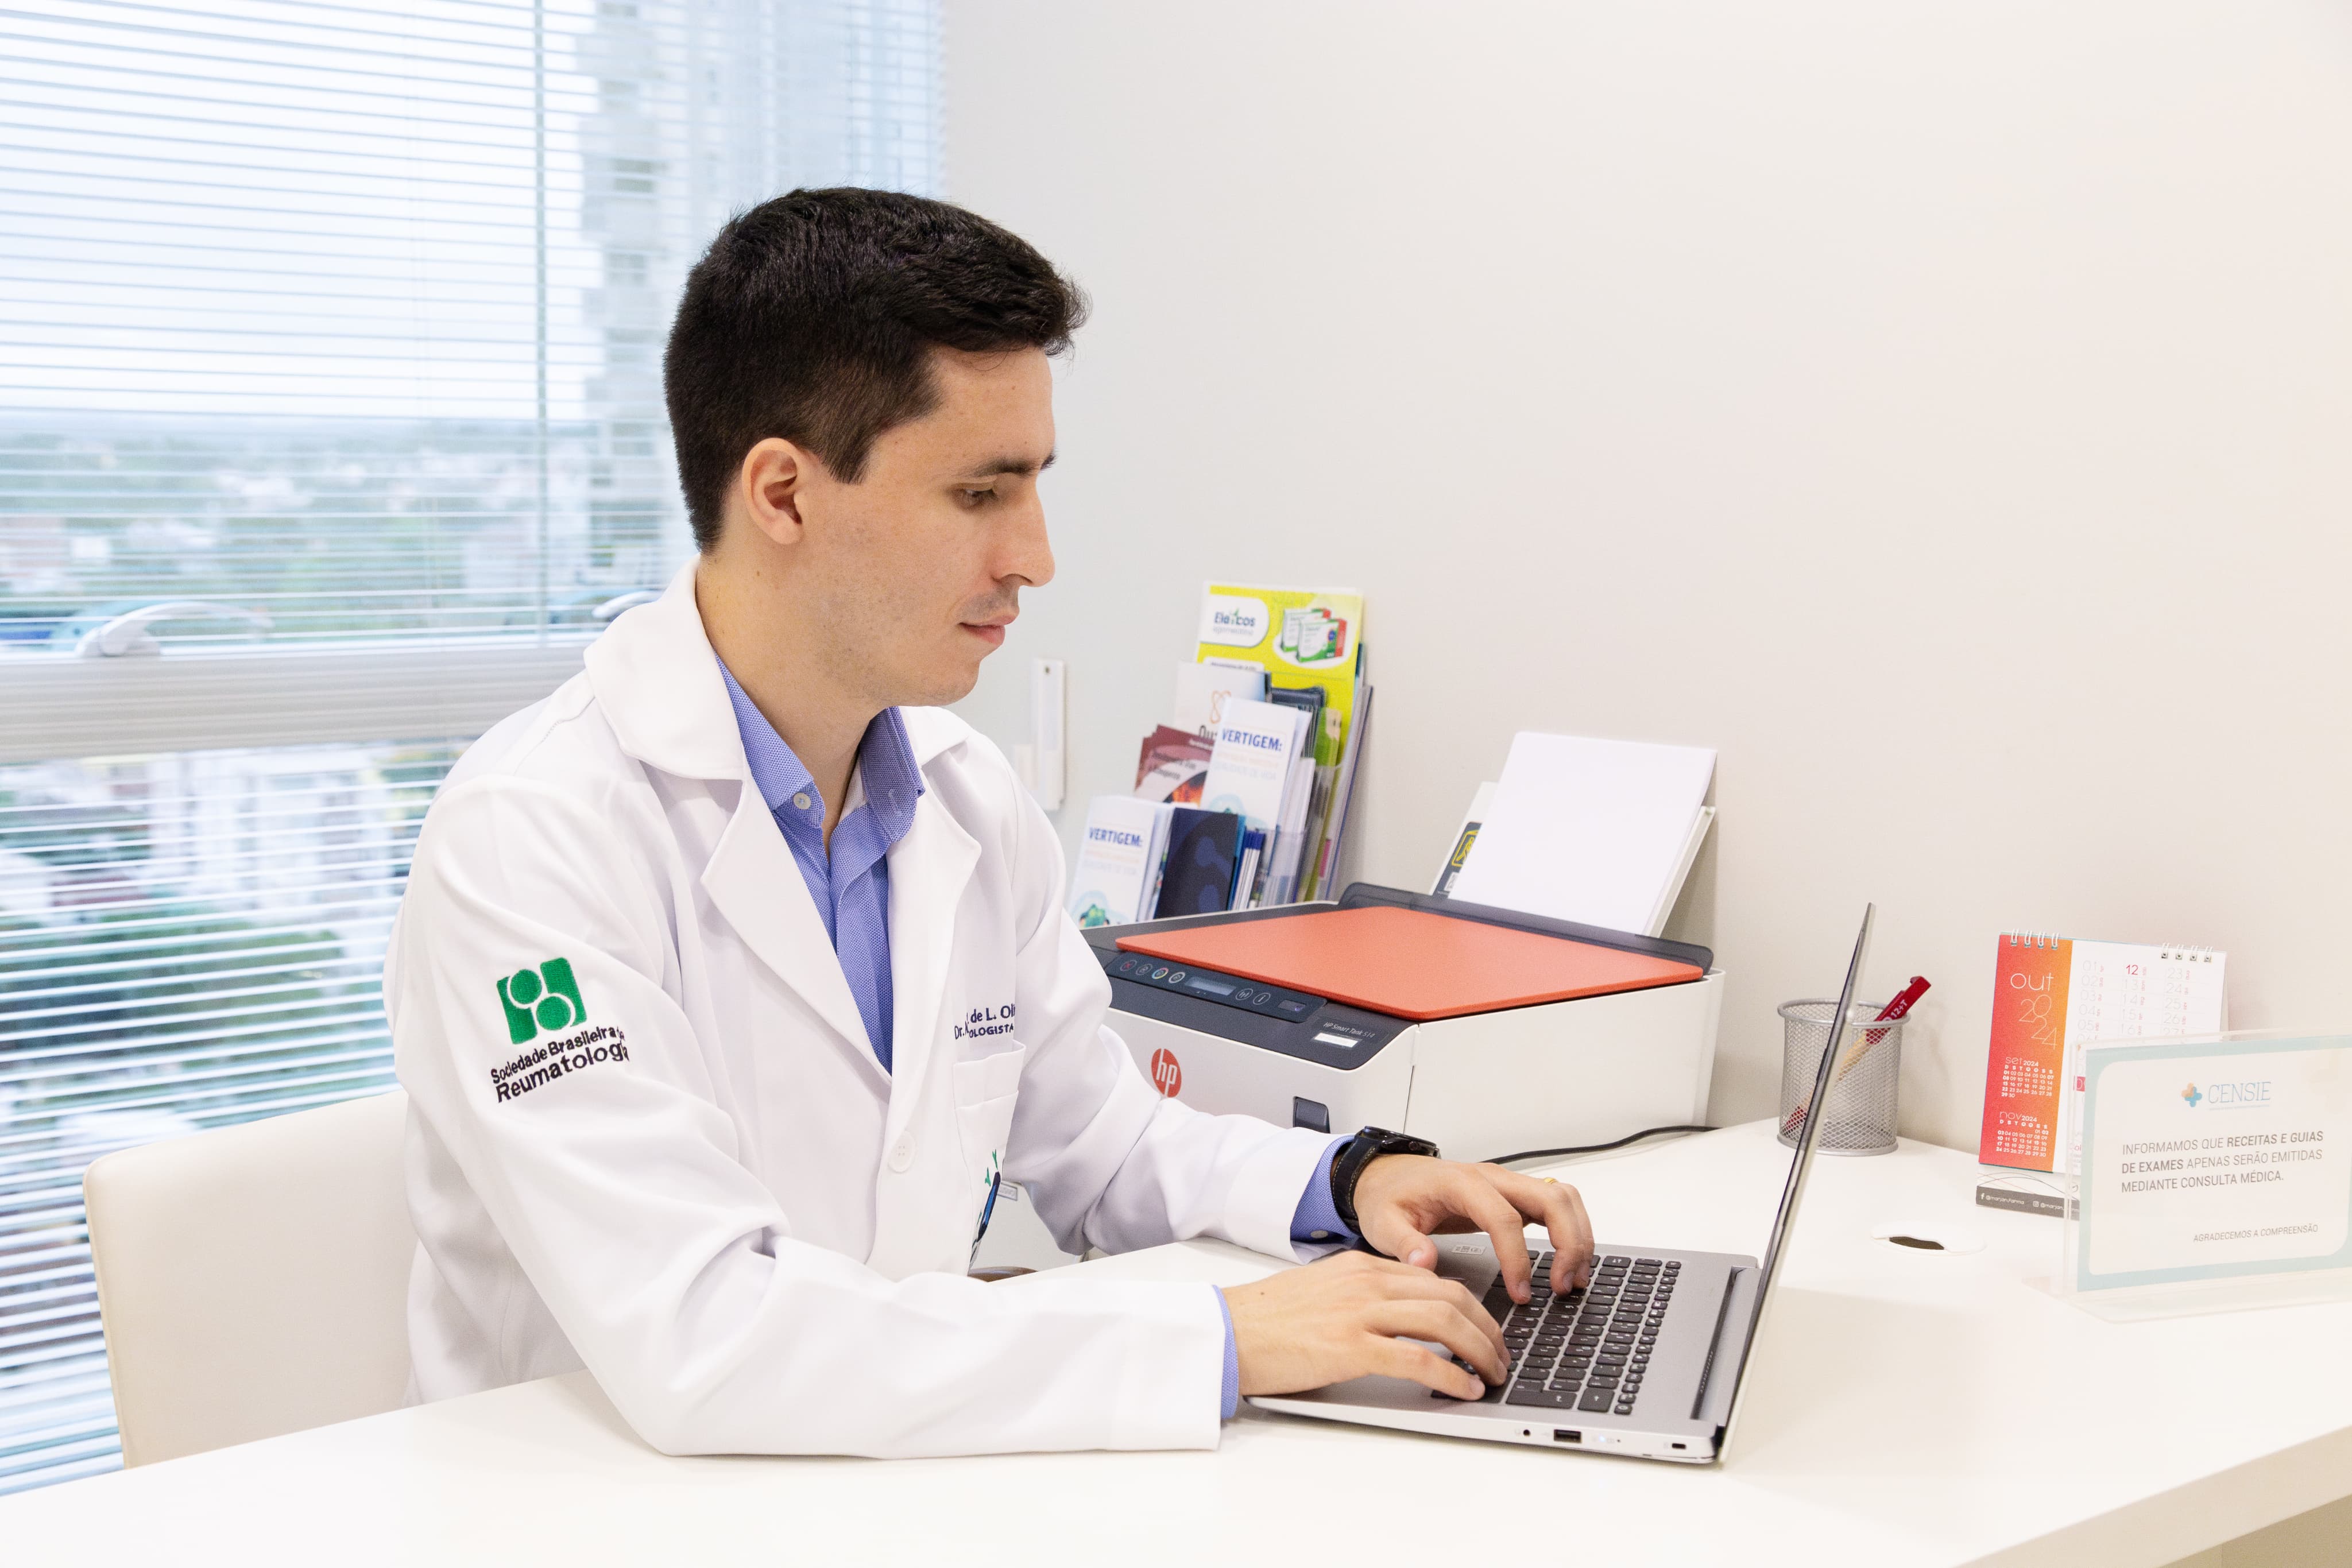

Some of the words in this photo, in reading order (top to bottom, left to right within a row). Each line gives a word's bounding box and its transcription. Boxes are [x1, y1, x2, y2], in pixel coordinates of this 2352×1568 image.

[1223, 728, 1282, 751] VERTIGEM:
[2126, 965, 2138, 975] 12
[2168, 968, 2183, 979] 23
[2010, 973, 2054, 992] out
[2167, 983, 2183, 993] 24
[2080, 990, 2096, 1001] 03
[2123, 994, 2138, 1005] 14
[2165, 997, 2182, 1010] 25
[970, 1009, 982, 1023] de
[2079, 1005, 2096, 1016] 04
[2122, 1009, 2136, 1020] 15
[2164, 1012, 2181, 1024] 26
[2077, 1020, 2095, 1031] 05
[2121, 1024, 2136, 1035] 16
[2006, 1056, 2022, 1064] set
[1154, 1048, 1178, 1096] hp
[2208, 1082, 2271, 1104] CENSIE
[1999, 1112, 2021, 1120] nov
[2122, 1139, 2198, 1155] INFORMAMOS
[2202, 1138, 2223, 1150] QUE
[2227, 1135, 2277, 1147] RECEITAS
[2281, 1133, 2287, 1143] E
[2290, 1131, 2323, 1143] GUIAS
[2122, 1163, 2136, 1174] DE
[2139, 1159, 2183, 1173] EXAMES
[2187, 1156, 2230, 1169] APENAS
[2233, 1152, 2268, 1166] SERÃO
[2272, 1149, 2323, 1163] EMITIDAS
[2122, 1178, 2178, 1193] MEDIANTE
[2181, 1174, 2237, 1188] CONSULTA
[2241, 1170, 2284, 1183] MÉDICA.
[2194, 1230, 2252, 1242] AGRADECEMOS
[2261, 1223, 2318, 1237] COMPREENSÃO
